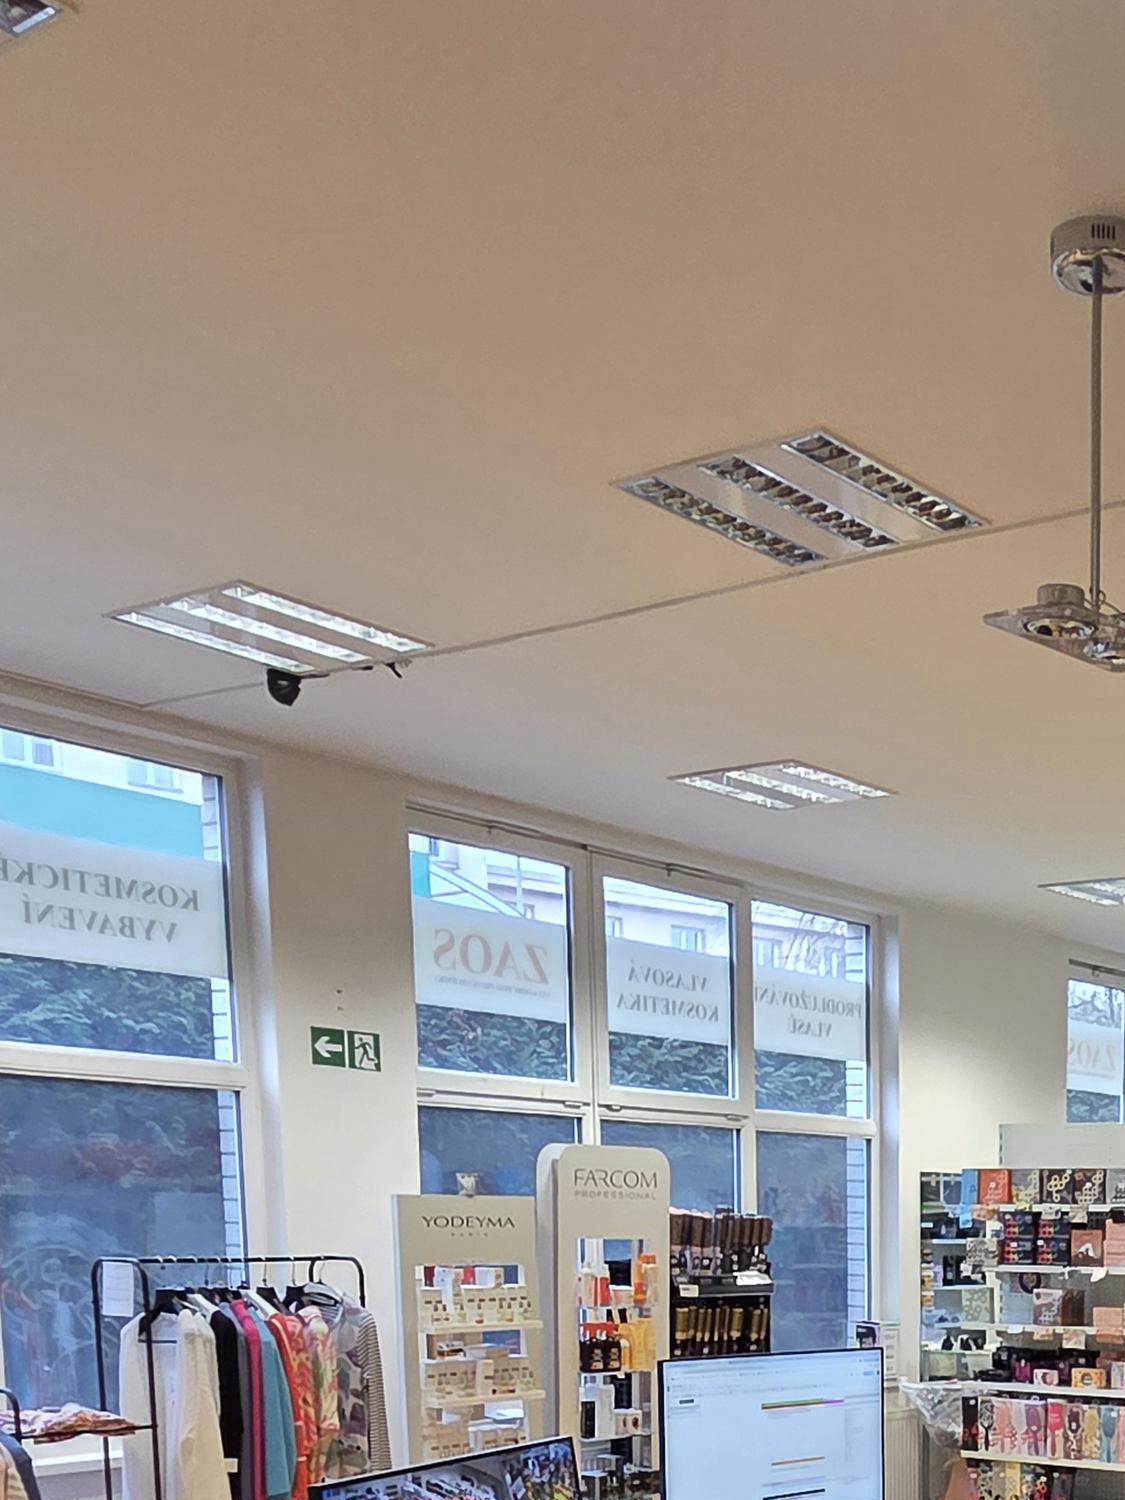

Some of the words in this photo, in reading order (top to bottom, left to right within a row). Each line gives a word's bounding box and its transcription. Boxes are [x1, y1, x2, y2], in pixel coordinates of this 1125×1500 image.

[573, 1168, 658, 1189] FARCOM
[574, 1190, 657, 1201] PROFESSIONAL
[421, 1216, 516, 1229] YODEYMA
